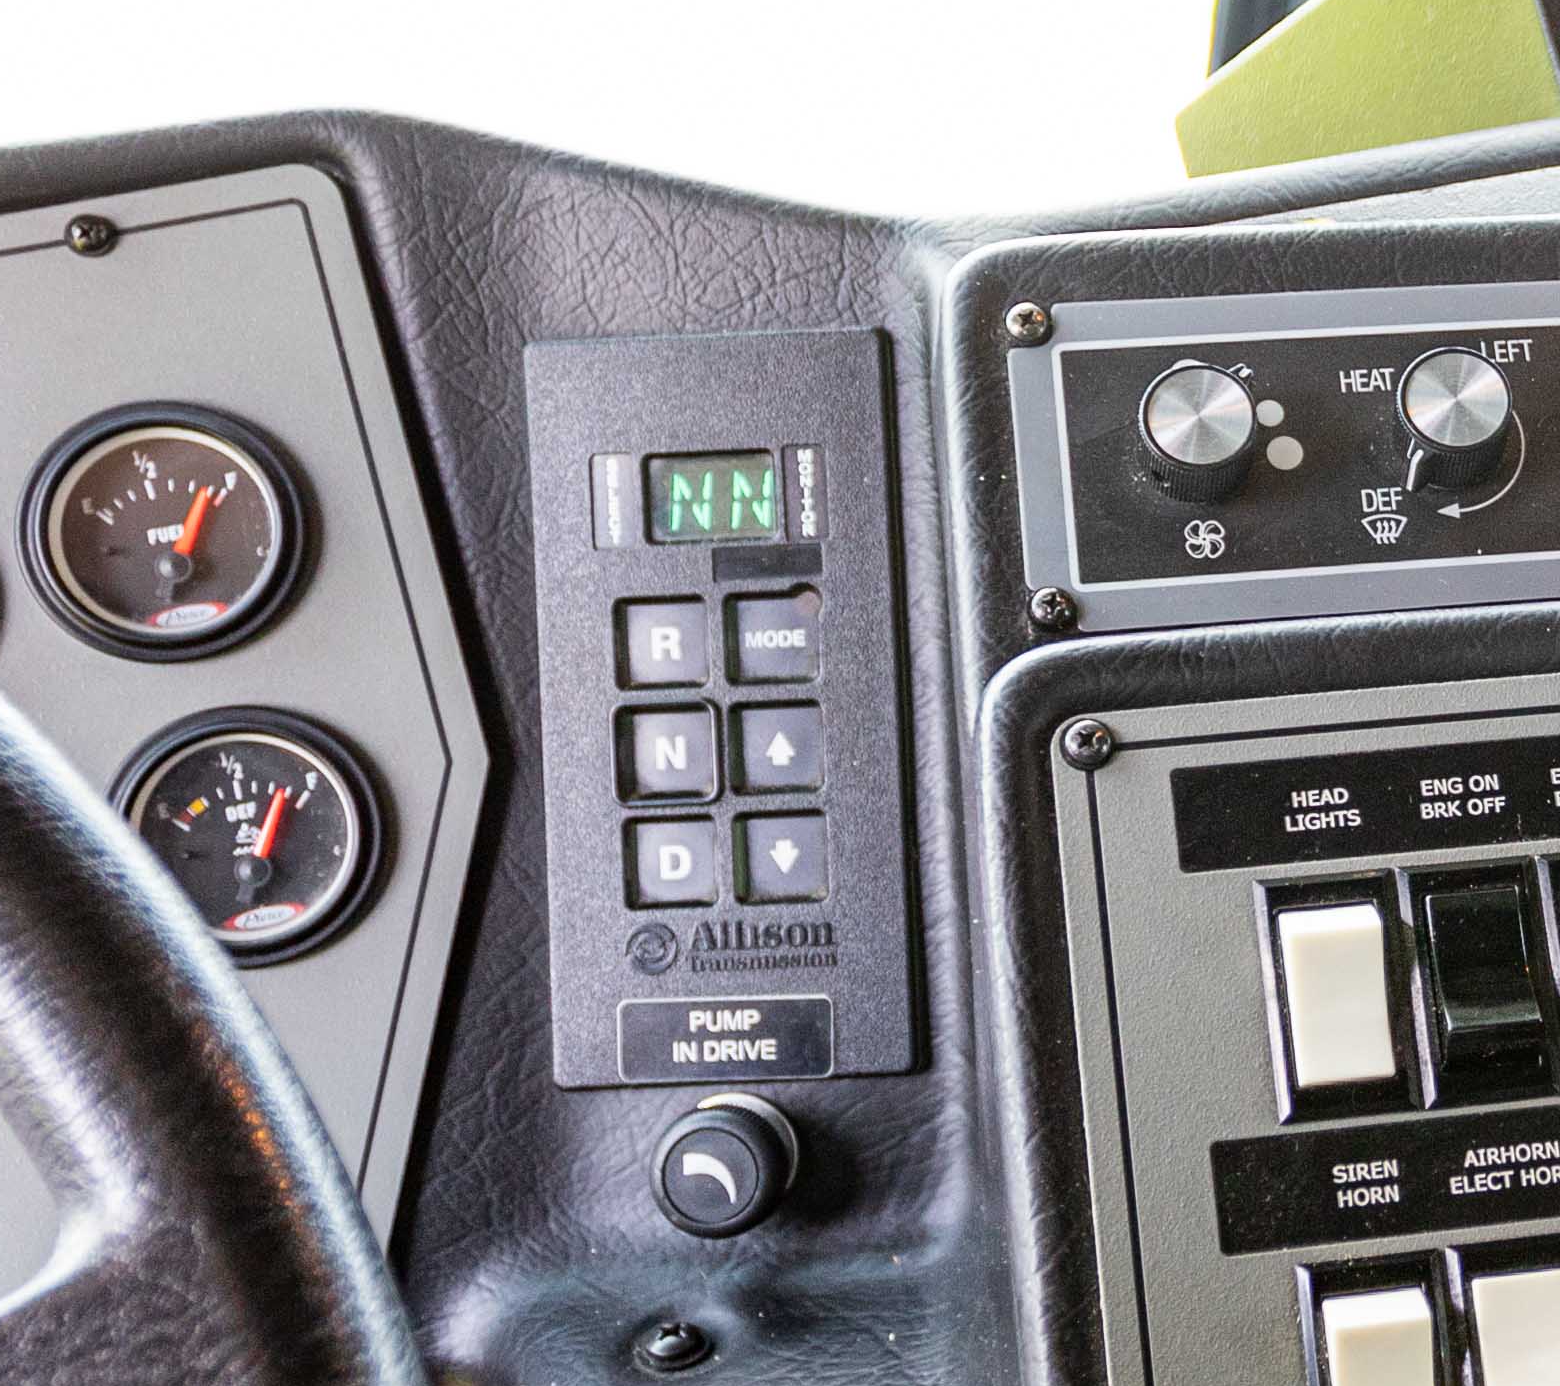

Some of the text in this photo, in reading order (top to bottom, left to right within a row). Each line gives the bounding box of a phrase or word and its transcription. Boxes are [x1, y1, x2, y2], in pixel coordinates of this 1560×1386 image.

[1480, 338, 1533, 365] LEFT
[1339, 366, 1395, 394] HEAT
[797, 449, 818, 537] MONITOR
[1361, 486, 1403, 513] DEF
[650, 626, 682, 661] R
[744, 628, 807, 650] MODE
[655, 735, 687, 771] N
[1420, 773, 1500, 797] ENG ON
[1291, 788, 1349, 809] HEAD
[1420, 796, 1506, 821] BRK OFF
[1284, 809, 1361, 833] LIGHTS
[658, 845, 693, 881] D
[690, 918, 838, 952] Allison
[686, 951, 838, 974] Transmission
[688, 1008, 761, 1033] PUMP
[672, 1038, 778, 1064] IN DRIVE
[1464, 1141, 1560, 1168] AIRHORN
[1332, 1160, 1399, 1185] SIREN
[1449, 1170, 1514, 1196] ELECT
[1337, 1184, 1400, 1209] HORN
